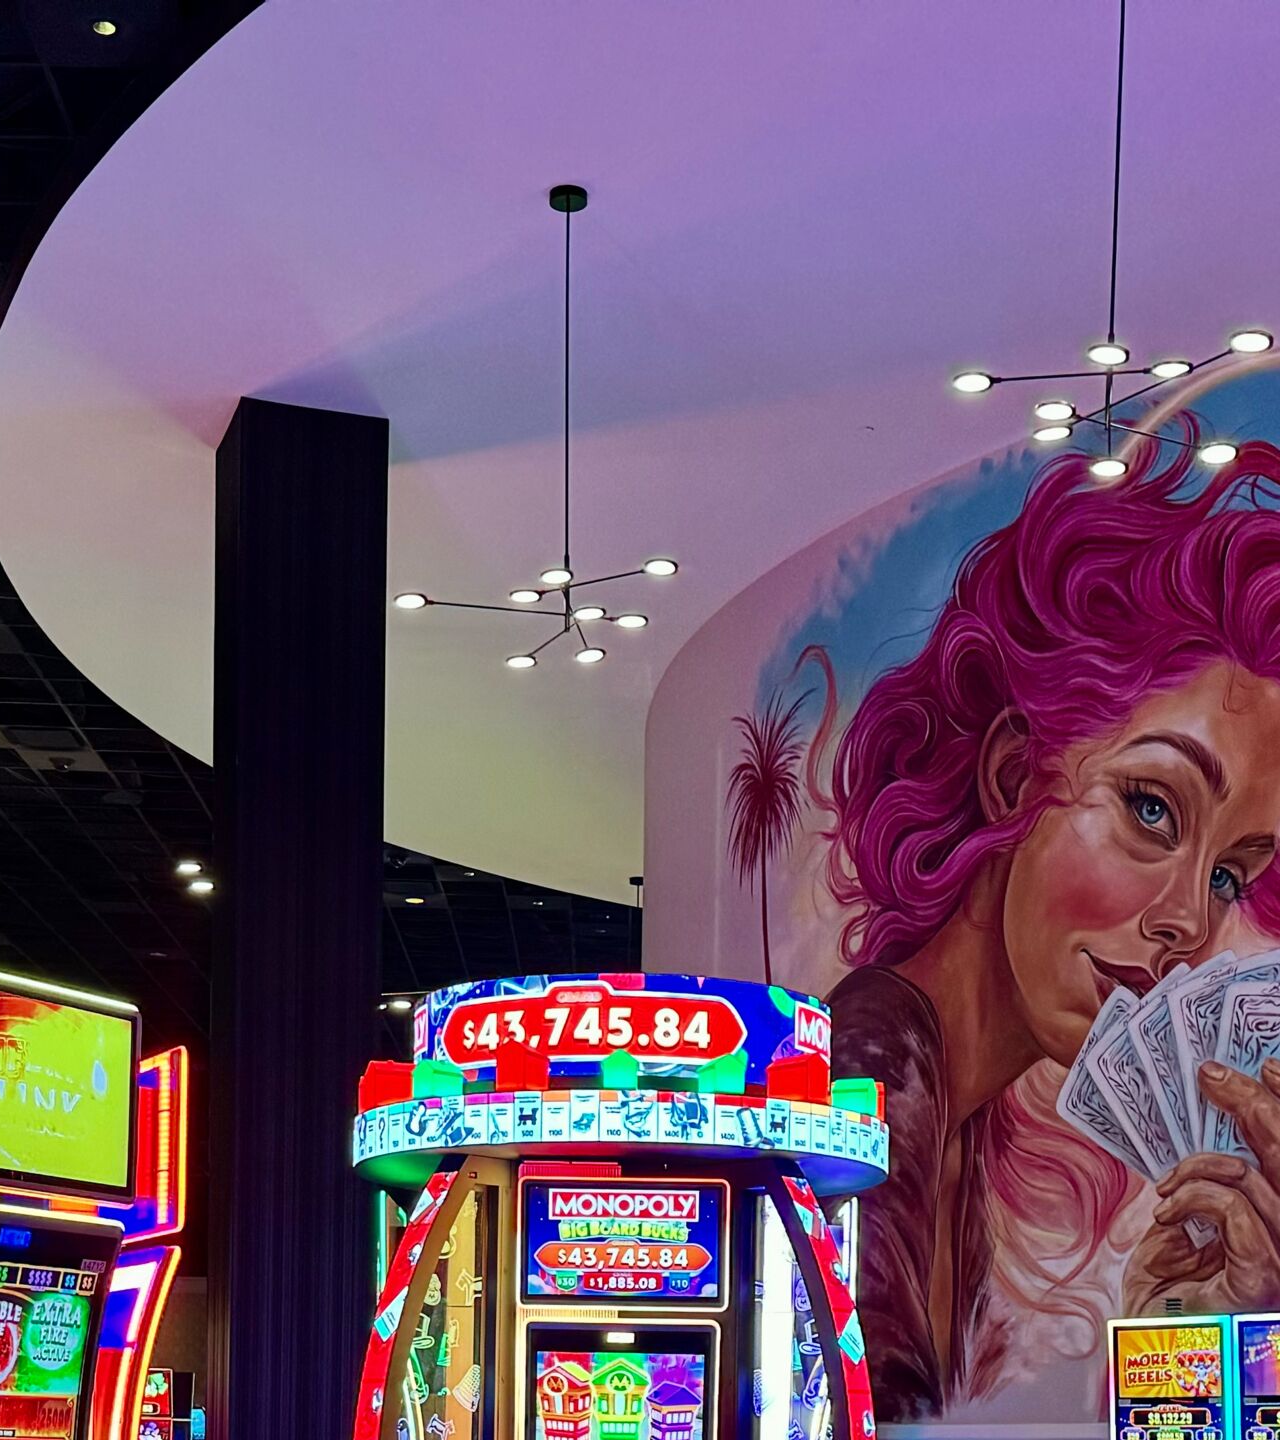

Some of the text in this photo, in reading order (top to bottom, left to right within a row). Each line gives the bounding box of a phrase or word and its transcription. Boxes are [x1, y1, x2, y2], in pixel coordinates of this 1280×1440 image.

[462, 1006, 711, 1051] $43,745.84
[554, 1193, 696, 1217] MONOPOLY
[559, 1220, 688, 1242] BIG BOARD BUCKS
[558, 1248, 689, 1270] $43,745.84
[32, 1300, 81, 1328] EXTRA
[39, 1327, 69, 1346] FIRE
[33, 1347, 70, 1362] ACTIVE
[1127, 1353, 1169, 1369] MORE
[1127, 1369, 1173, 1386] REELS
